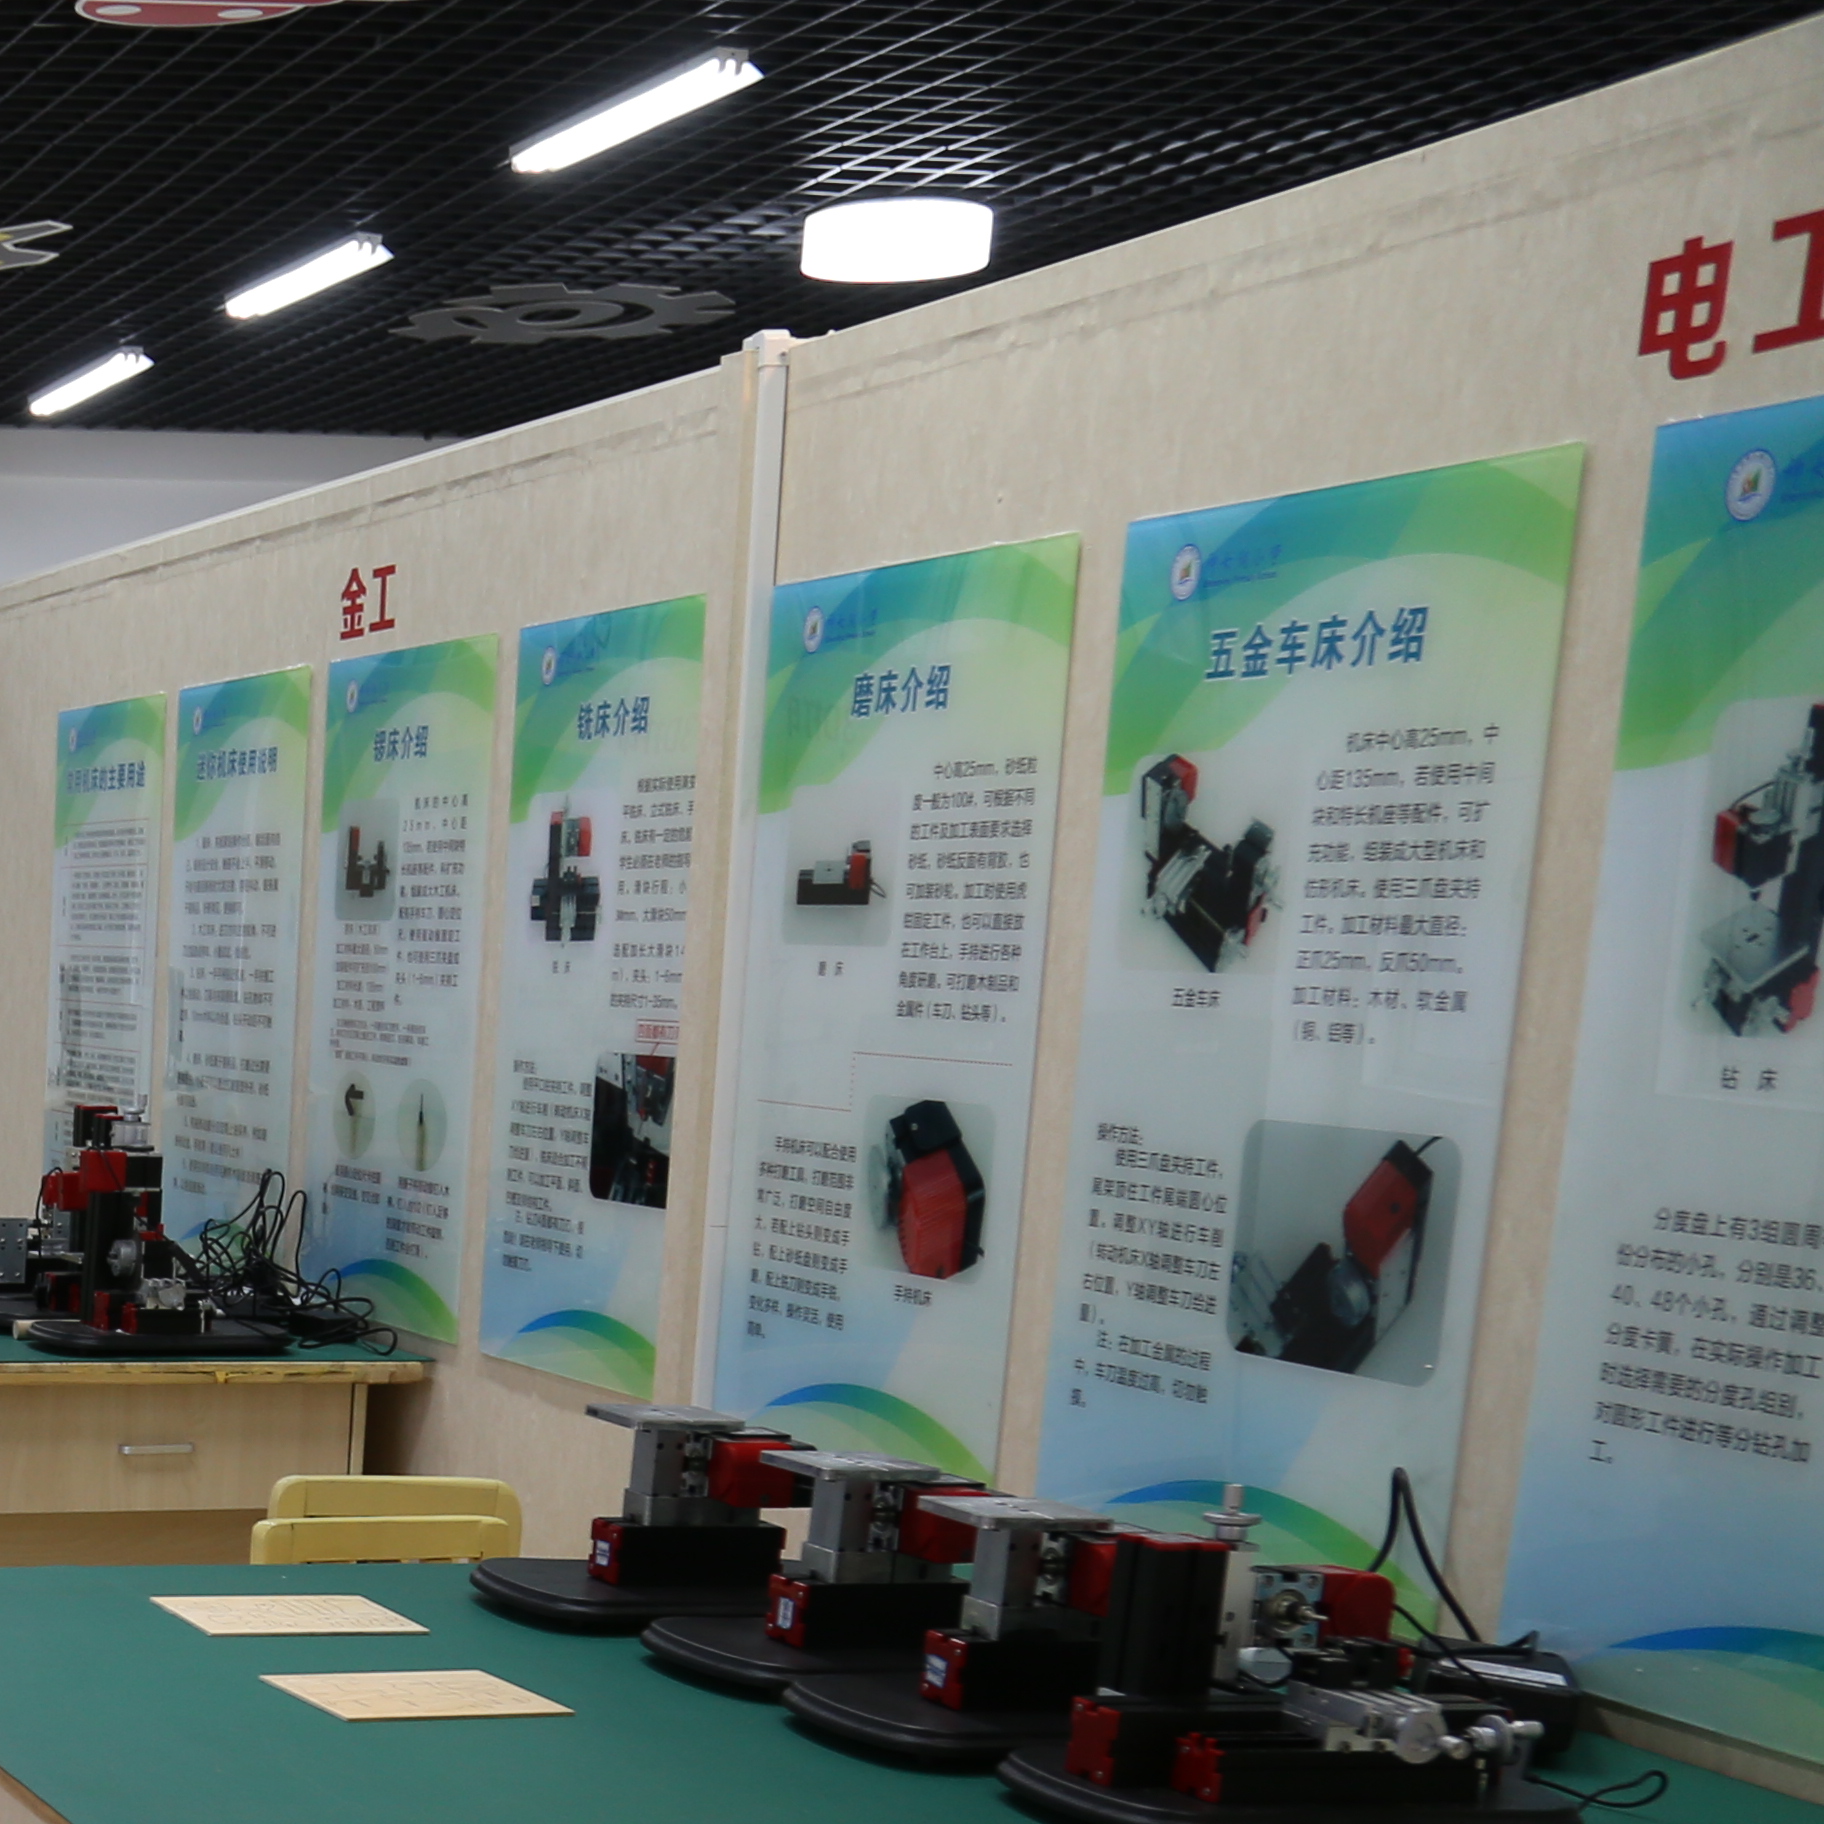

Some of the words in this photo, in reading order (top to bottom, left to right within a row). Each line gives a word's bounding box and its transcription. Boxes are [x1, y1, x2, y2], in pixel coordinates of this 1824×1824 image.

[1638, 236, 1824, 379] 电工
[340, 565, 396, 641] 金工
[1205, 607, 1429, 681] 五金车床介绍
[577, 696, 650, 740] 铣床介绍
[851, 664, 951, 718] 磨床介绍
[1170, 986, 1221, 1011] 五金车床
[1720, 1065, 1779, 1092] 钻床
